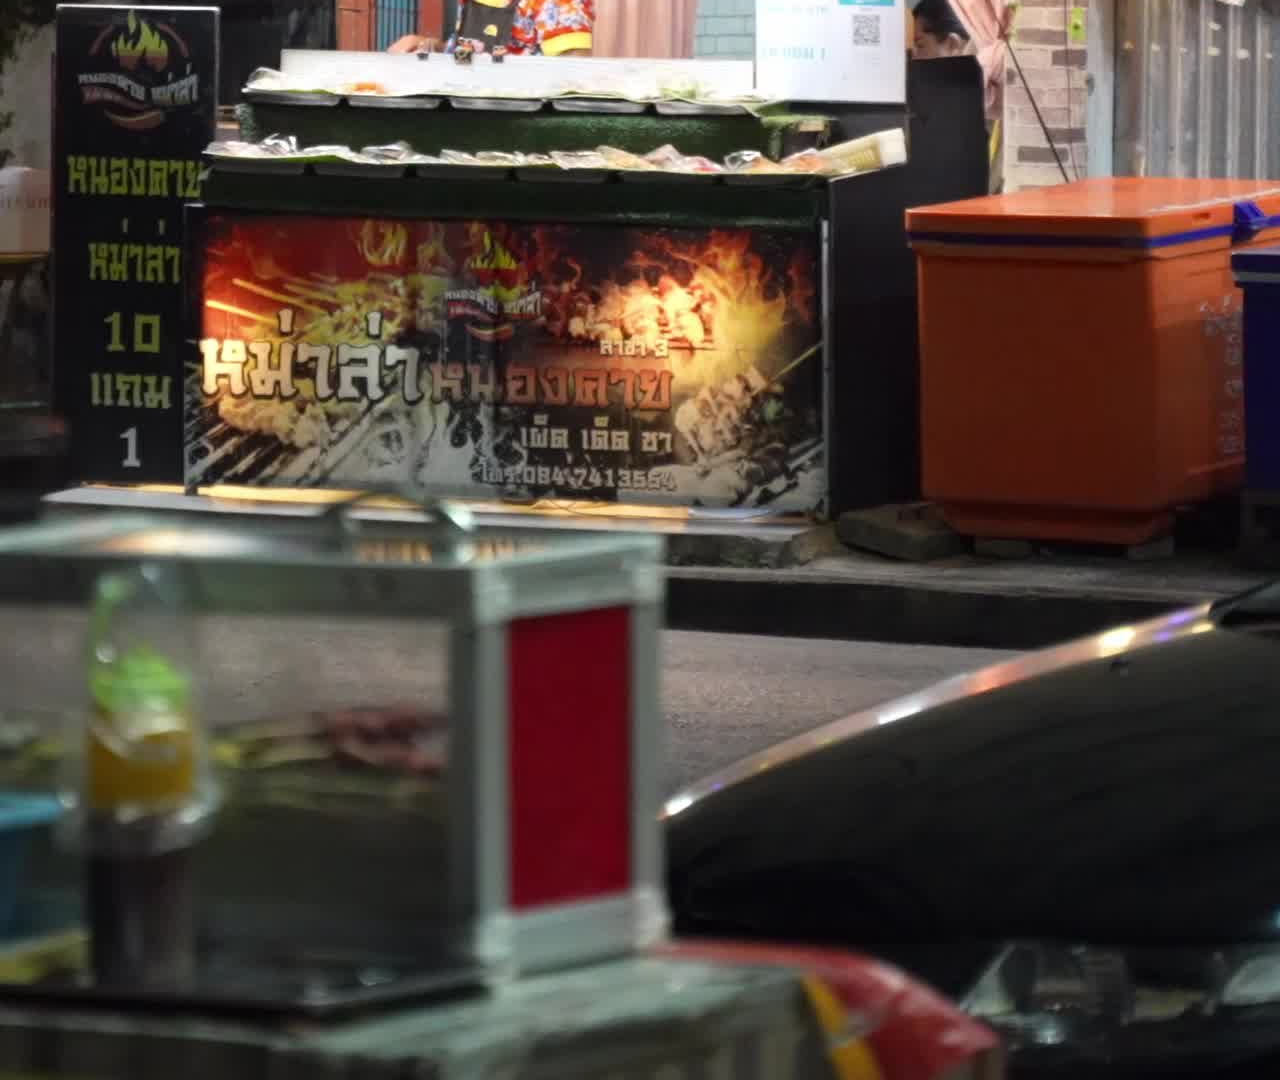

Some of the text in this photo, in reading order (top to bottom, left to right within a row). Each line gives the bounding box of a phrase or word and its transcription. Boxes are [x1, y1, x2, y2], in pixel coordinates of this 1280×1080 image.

[68, 154, 205, 197] หนองคาย
[88, 219, 181, 284] หม่าล่า
[104, 312, 161, 354] 10
[652, 339, 669, 358] 3
[198, 309, 420, 404] หม่าล่า
[90, 372, 172, 409] แถม
[430, 360, 674, 413] หนองคาย
[120, 427, 142, 468] 1
[521, 413, 569, 449] เผ็ด
[581, 415, 630, 452] เด็ด
